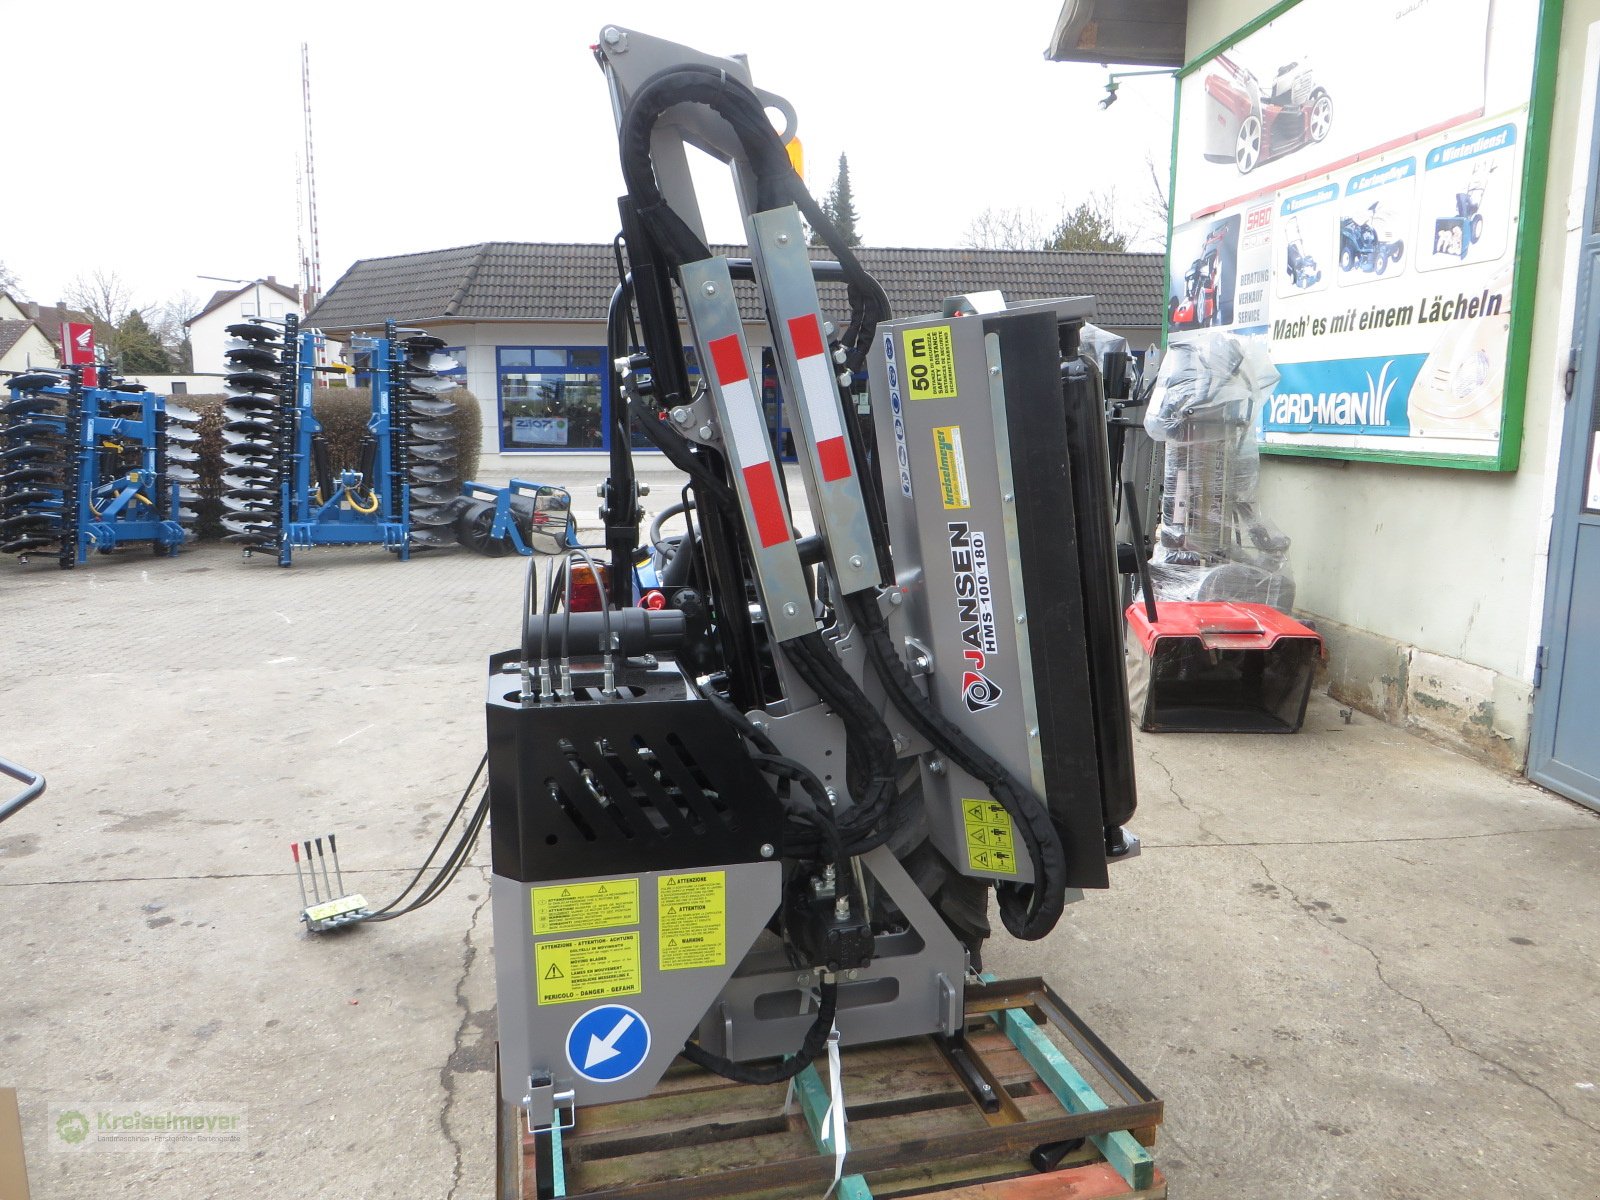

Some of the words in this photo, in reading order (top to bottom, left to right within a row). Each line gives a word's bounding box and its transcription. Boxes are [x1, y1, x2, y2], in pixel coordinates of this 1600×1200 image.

[1442, 130, 1507, 162] Winterdienst
[1247, 207, 1272, 230] SABO
[1240, 269, 1269, 286] BERATUNG
[1238, 289, 1263, 305] VERKAUF
[1238, 309, 1260, 323] SERVICE
[1312, 317, 1327, 336] es
[1330, 308, 1357, 334] mit
[1359, 304, 1413, 330] einem
[1418, 289, 1503, 324] Lächeln
[911, 338, 926, 358] m
[932, 332, 941, 365] DISTANCE
[911, 364, 930, 391] 50
[936, 368, 944, 394] SAFETY
[948, 522, 985, 670] JANSEN
[544, 992, 574, 1000] PERICOLO
[580, 988, 604, 996] DANGER
